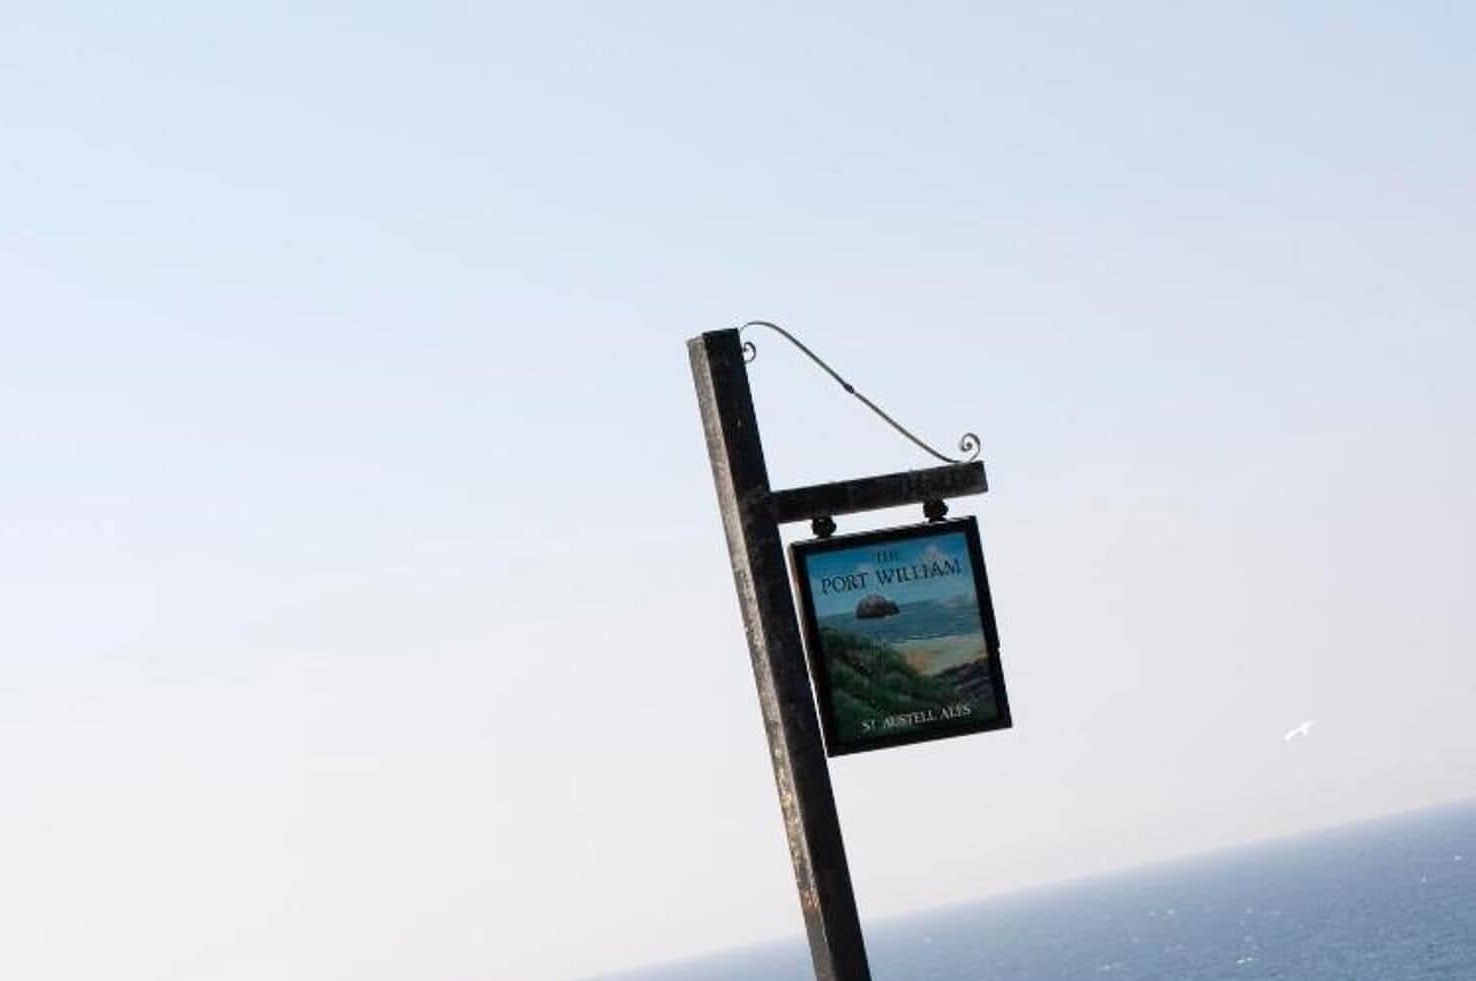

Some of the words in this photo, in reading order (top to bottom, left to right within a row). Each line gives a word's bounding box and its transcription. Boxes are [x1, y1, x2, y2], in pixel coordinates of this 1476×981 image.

[821, 572, 869, 594] PORT
[875, 557, 962, 585] WILLIAM
[884, 709, 937, 729] AUSTELL
[940, 703, 972, 721] ALES
